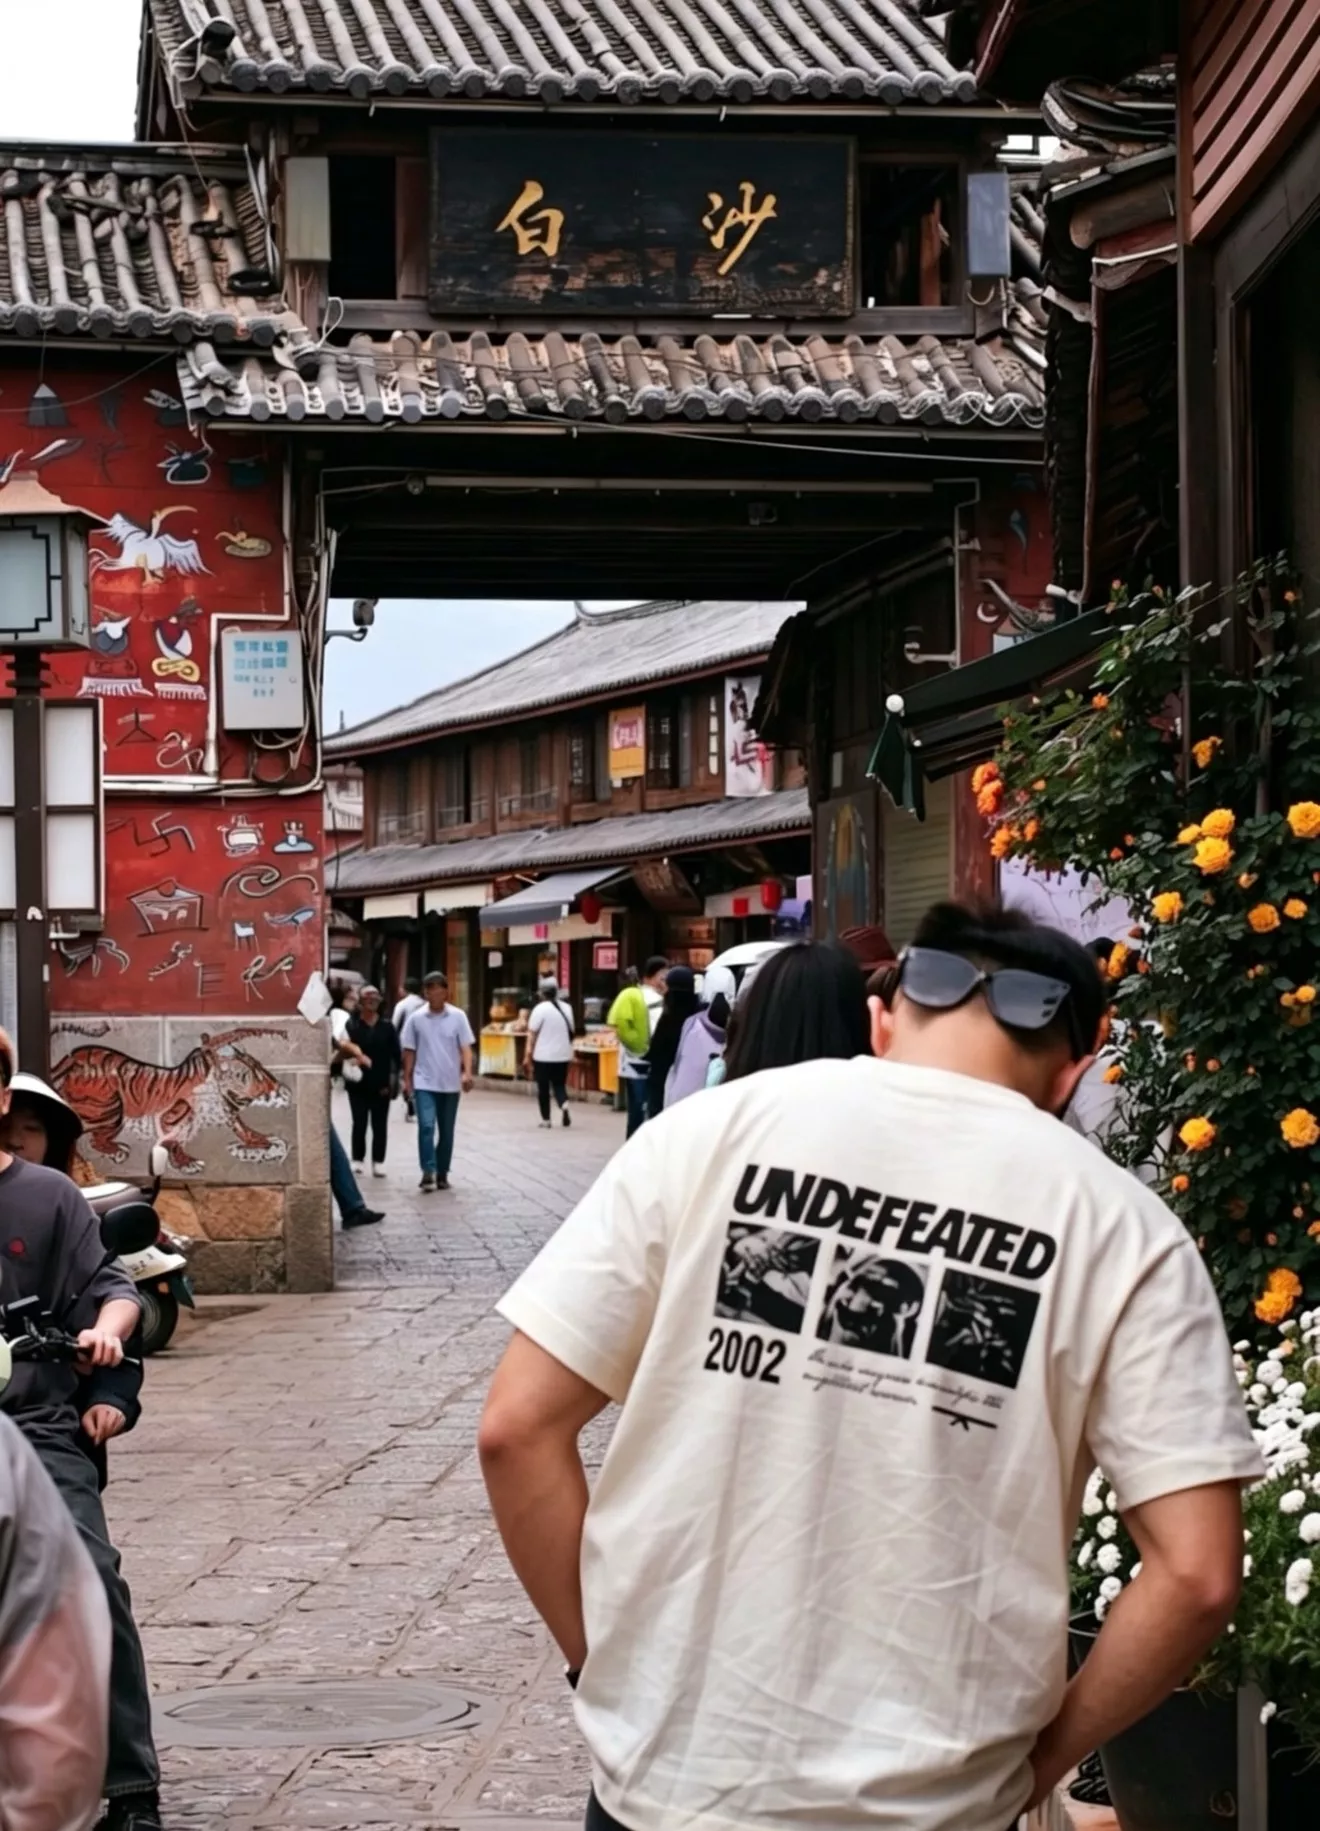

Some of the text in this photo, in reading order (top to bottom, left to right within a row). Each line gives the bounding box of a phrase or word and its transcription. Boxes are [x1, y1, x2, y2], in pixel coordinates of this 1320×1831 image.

[495, 180, 777, 275] 白沙
[733, 1163, 1058, 1281] UNDEFEATED
[703, 1327, 787, 1384] 2002
